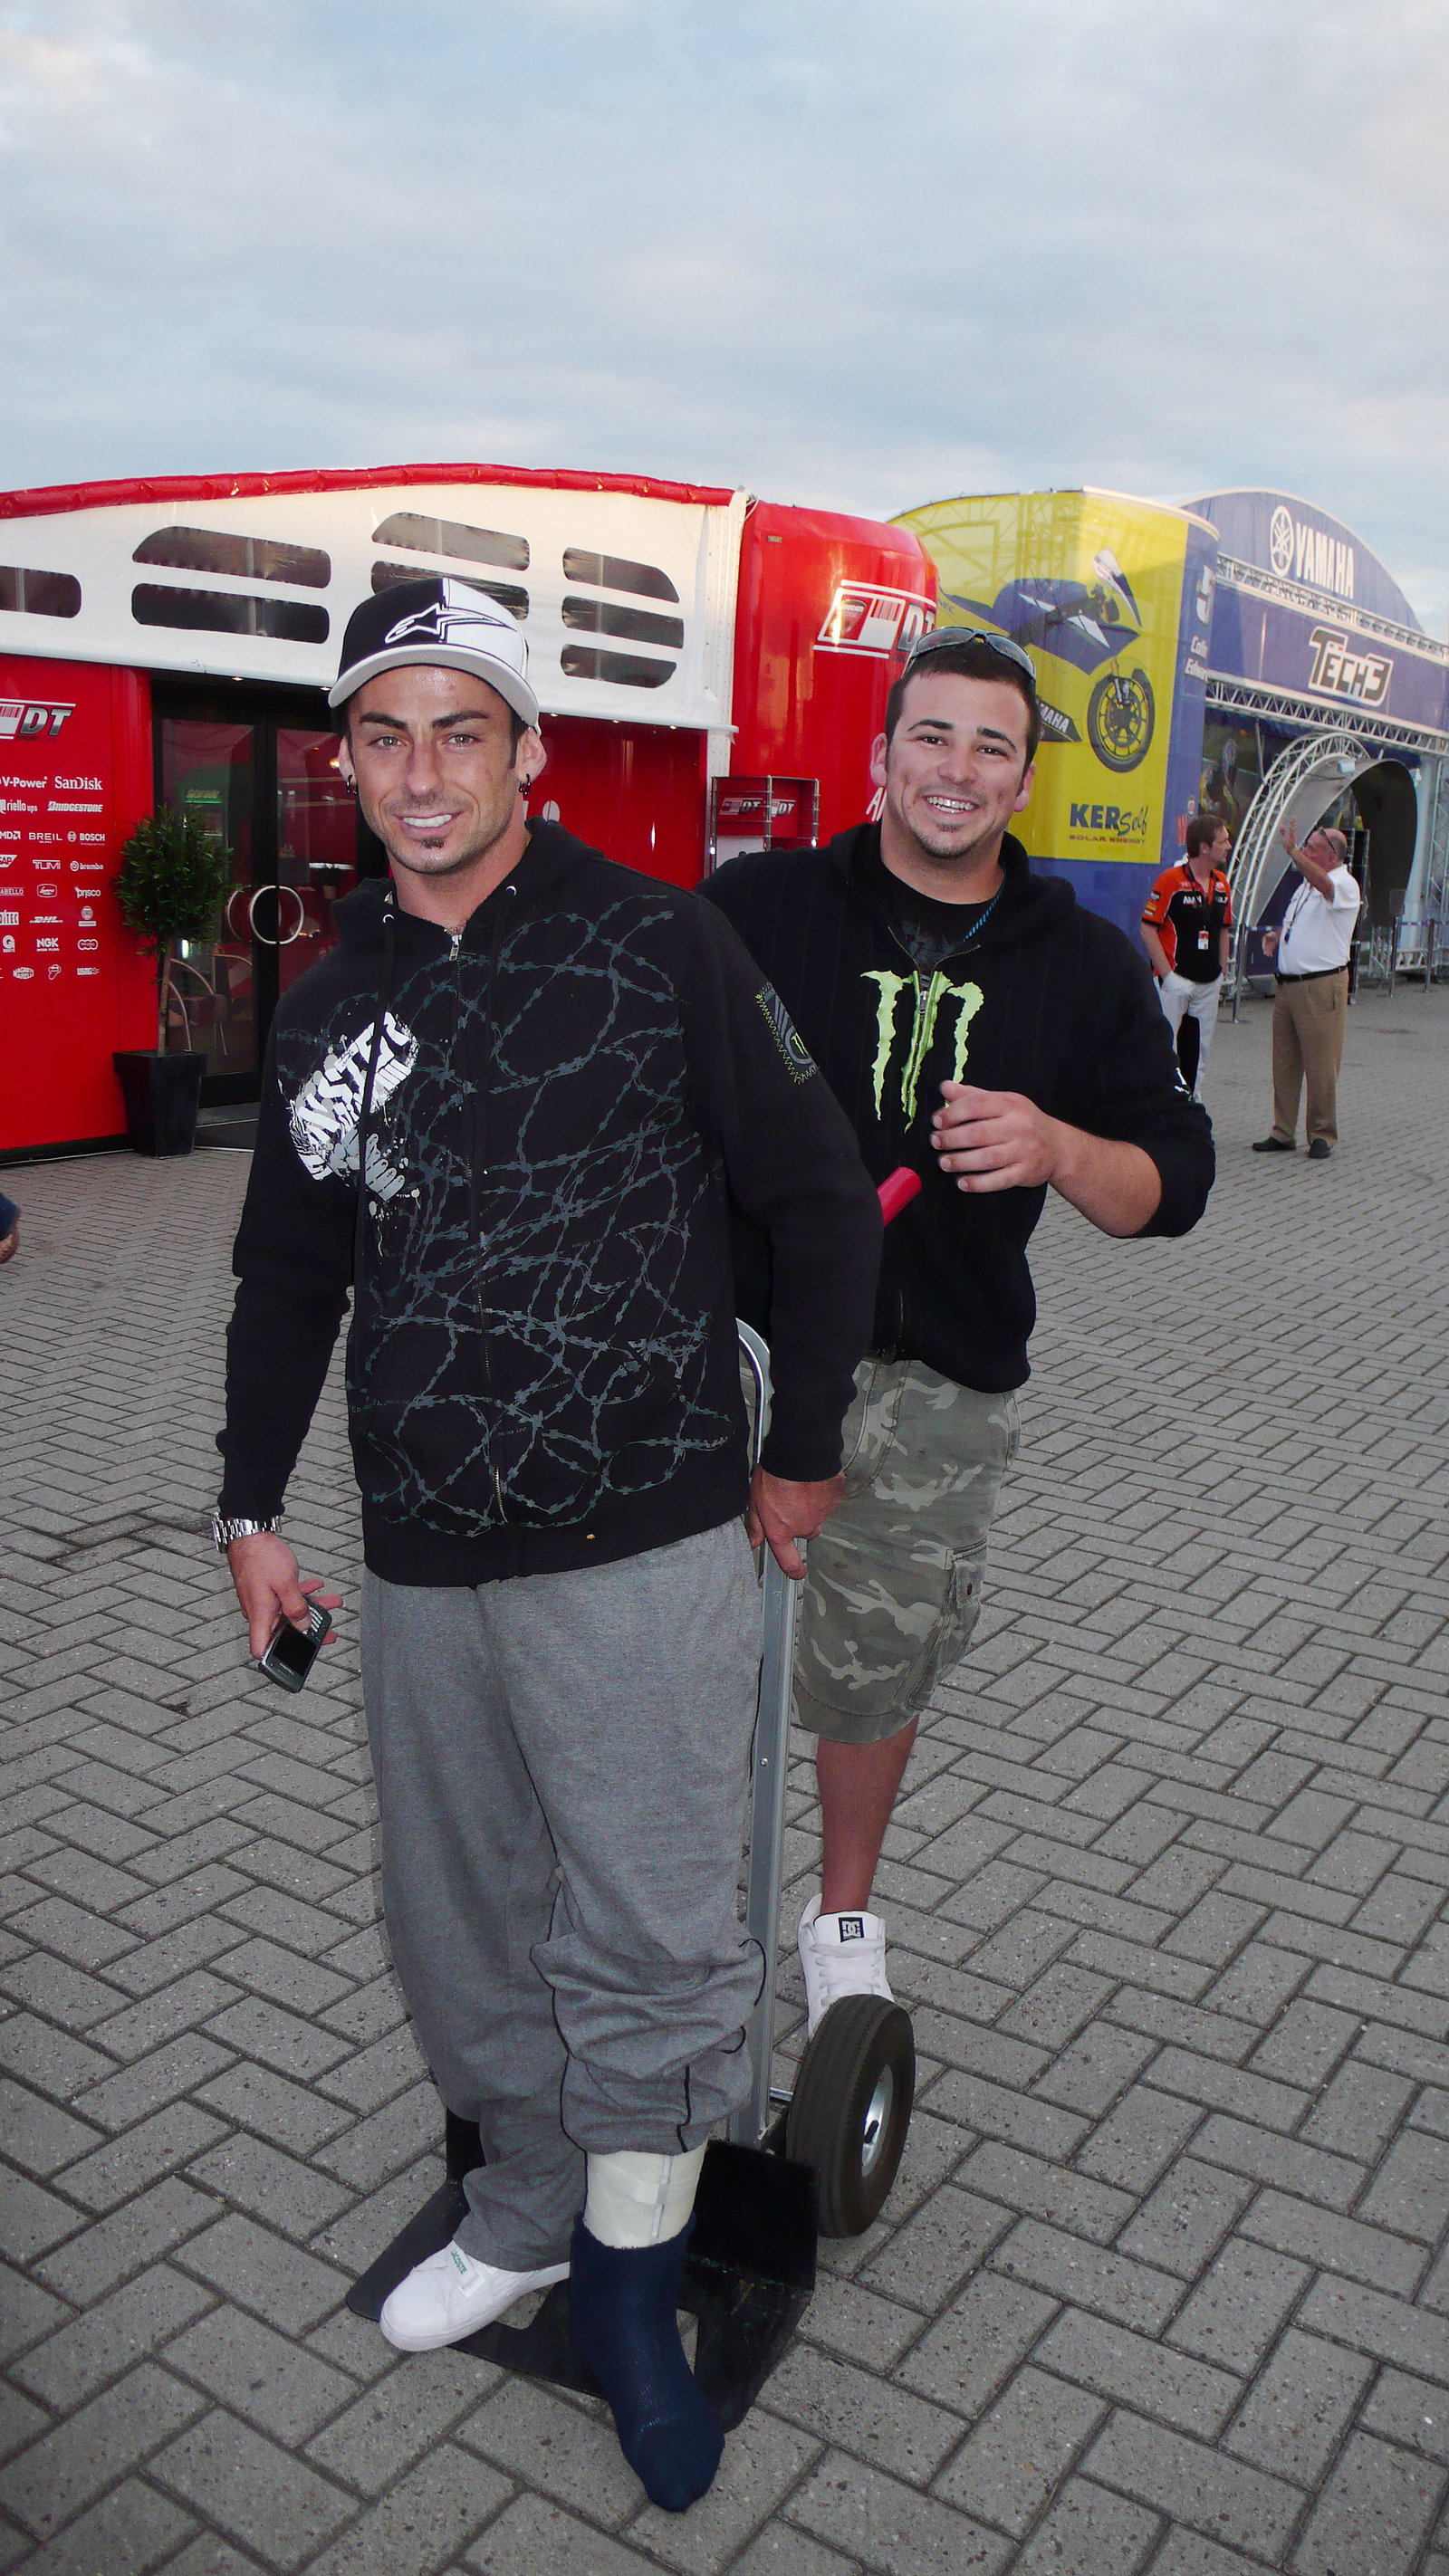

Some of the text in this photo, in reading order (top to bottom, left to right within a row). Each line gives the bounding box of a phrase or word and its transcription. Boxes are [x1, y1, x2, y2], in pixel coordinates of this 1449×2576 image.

[1295, 522, 1355, 599] YAMAHA
[19, 706, 72, 736] DT
[1038, 701, 1070, 733] MAHA
[2, 776, 103, 790] V-Power SanDisk
[47, 800, 103, 812] BRIDGESTONE
[0, 830, 15, 840] MD
[28, 832, 63, 841] BREIL
[79, 833, 106, 842] BOSCH
[33, 859, 61, 869] TUMI
[36, 938, 59, 947] NGK
